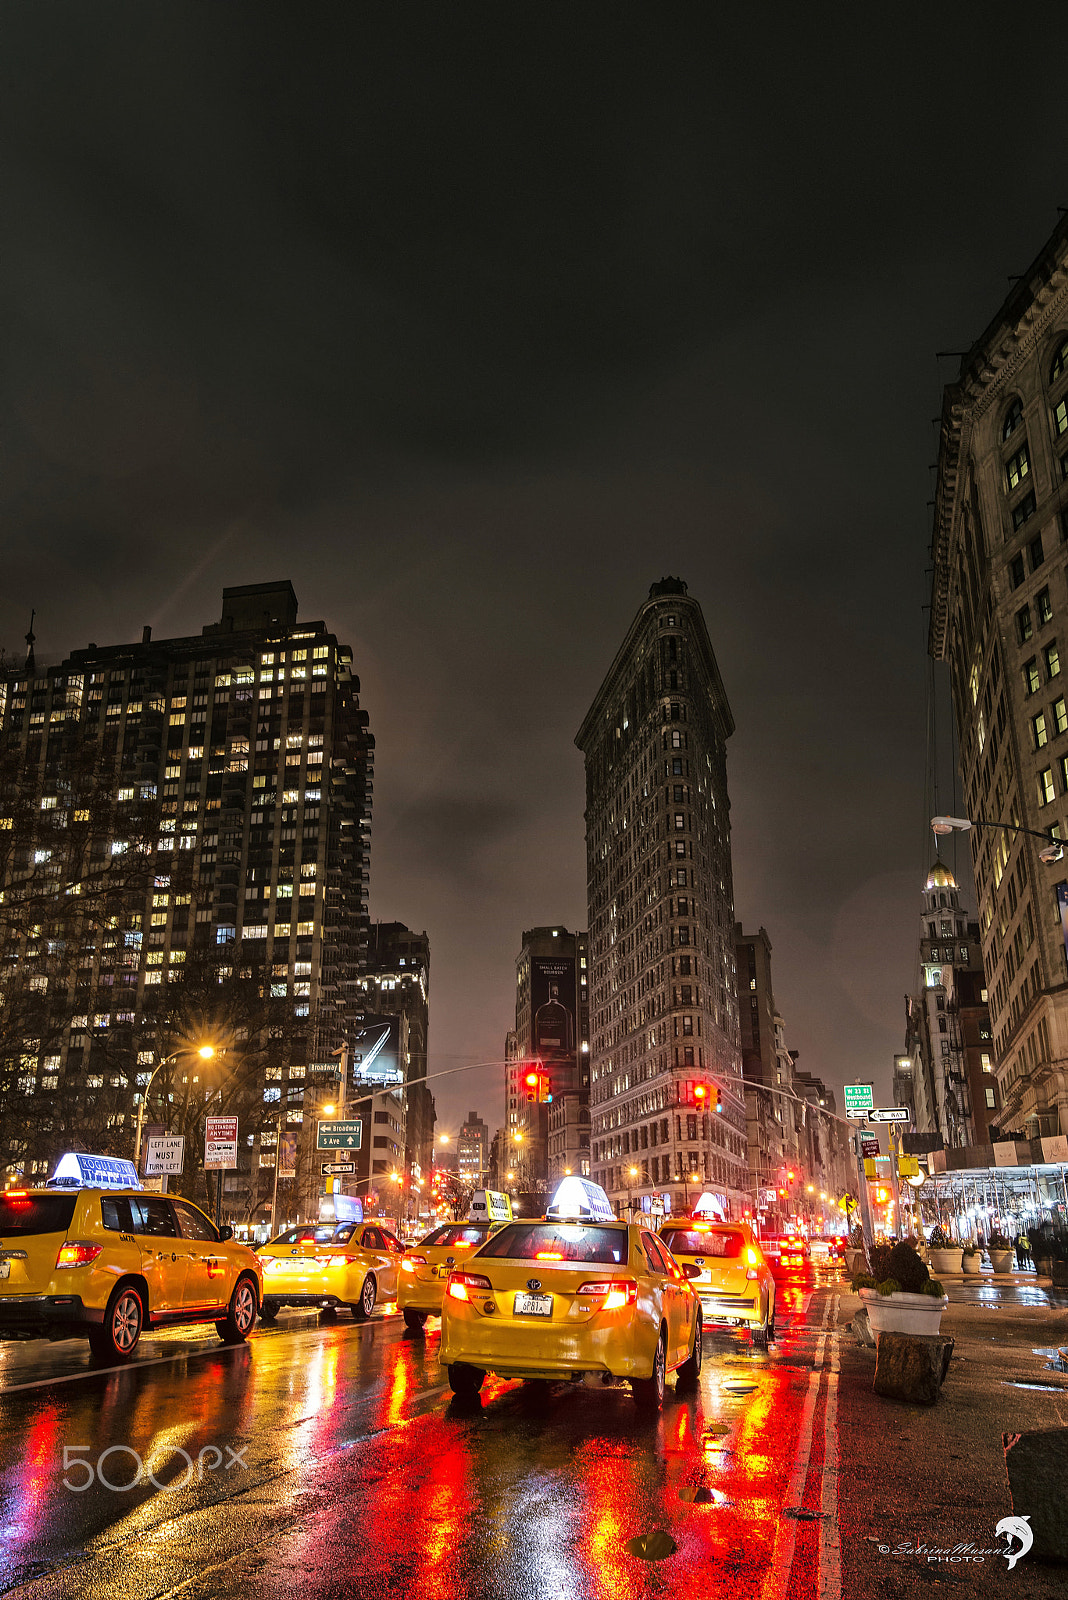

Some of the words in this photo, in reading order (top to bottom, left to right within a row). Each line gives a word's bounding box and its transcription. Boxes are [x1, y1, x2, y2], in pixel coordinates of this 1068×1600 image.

[311, 1064, 338, 1073] Broadway
[332, 1125, 360, 1133] Broadway
[155, 1152, 175, 1160] MUST
[81, 1159, 112, 1172] ROGUE
[114, 1163, 136, 1176] ONE
